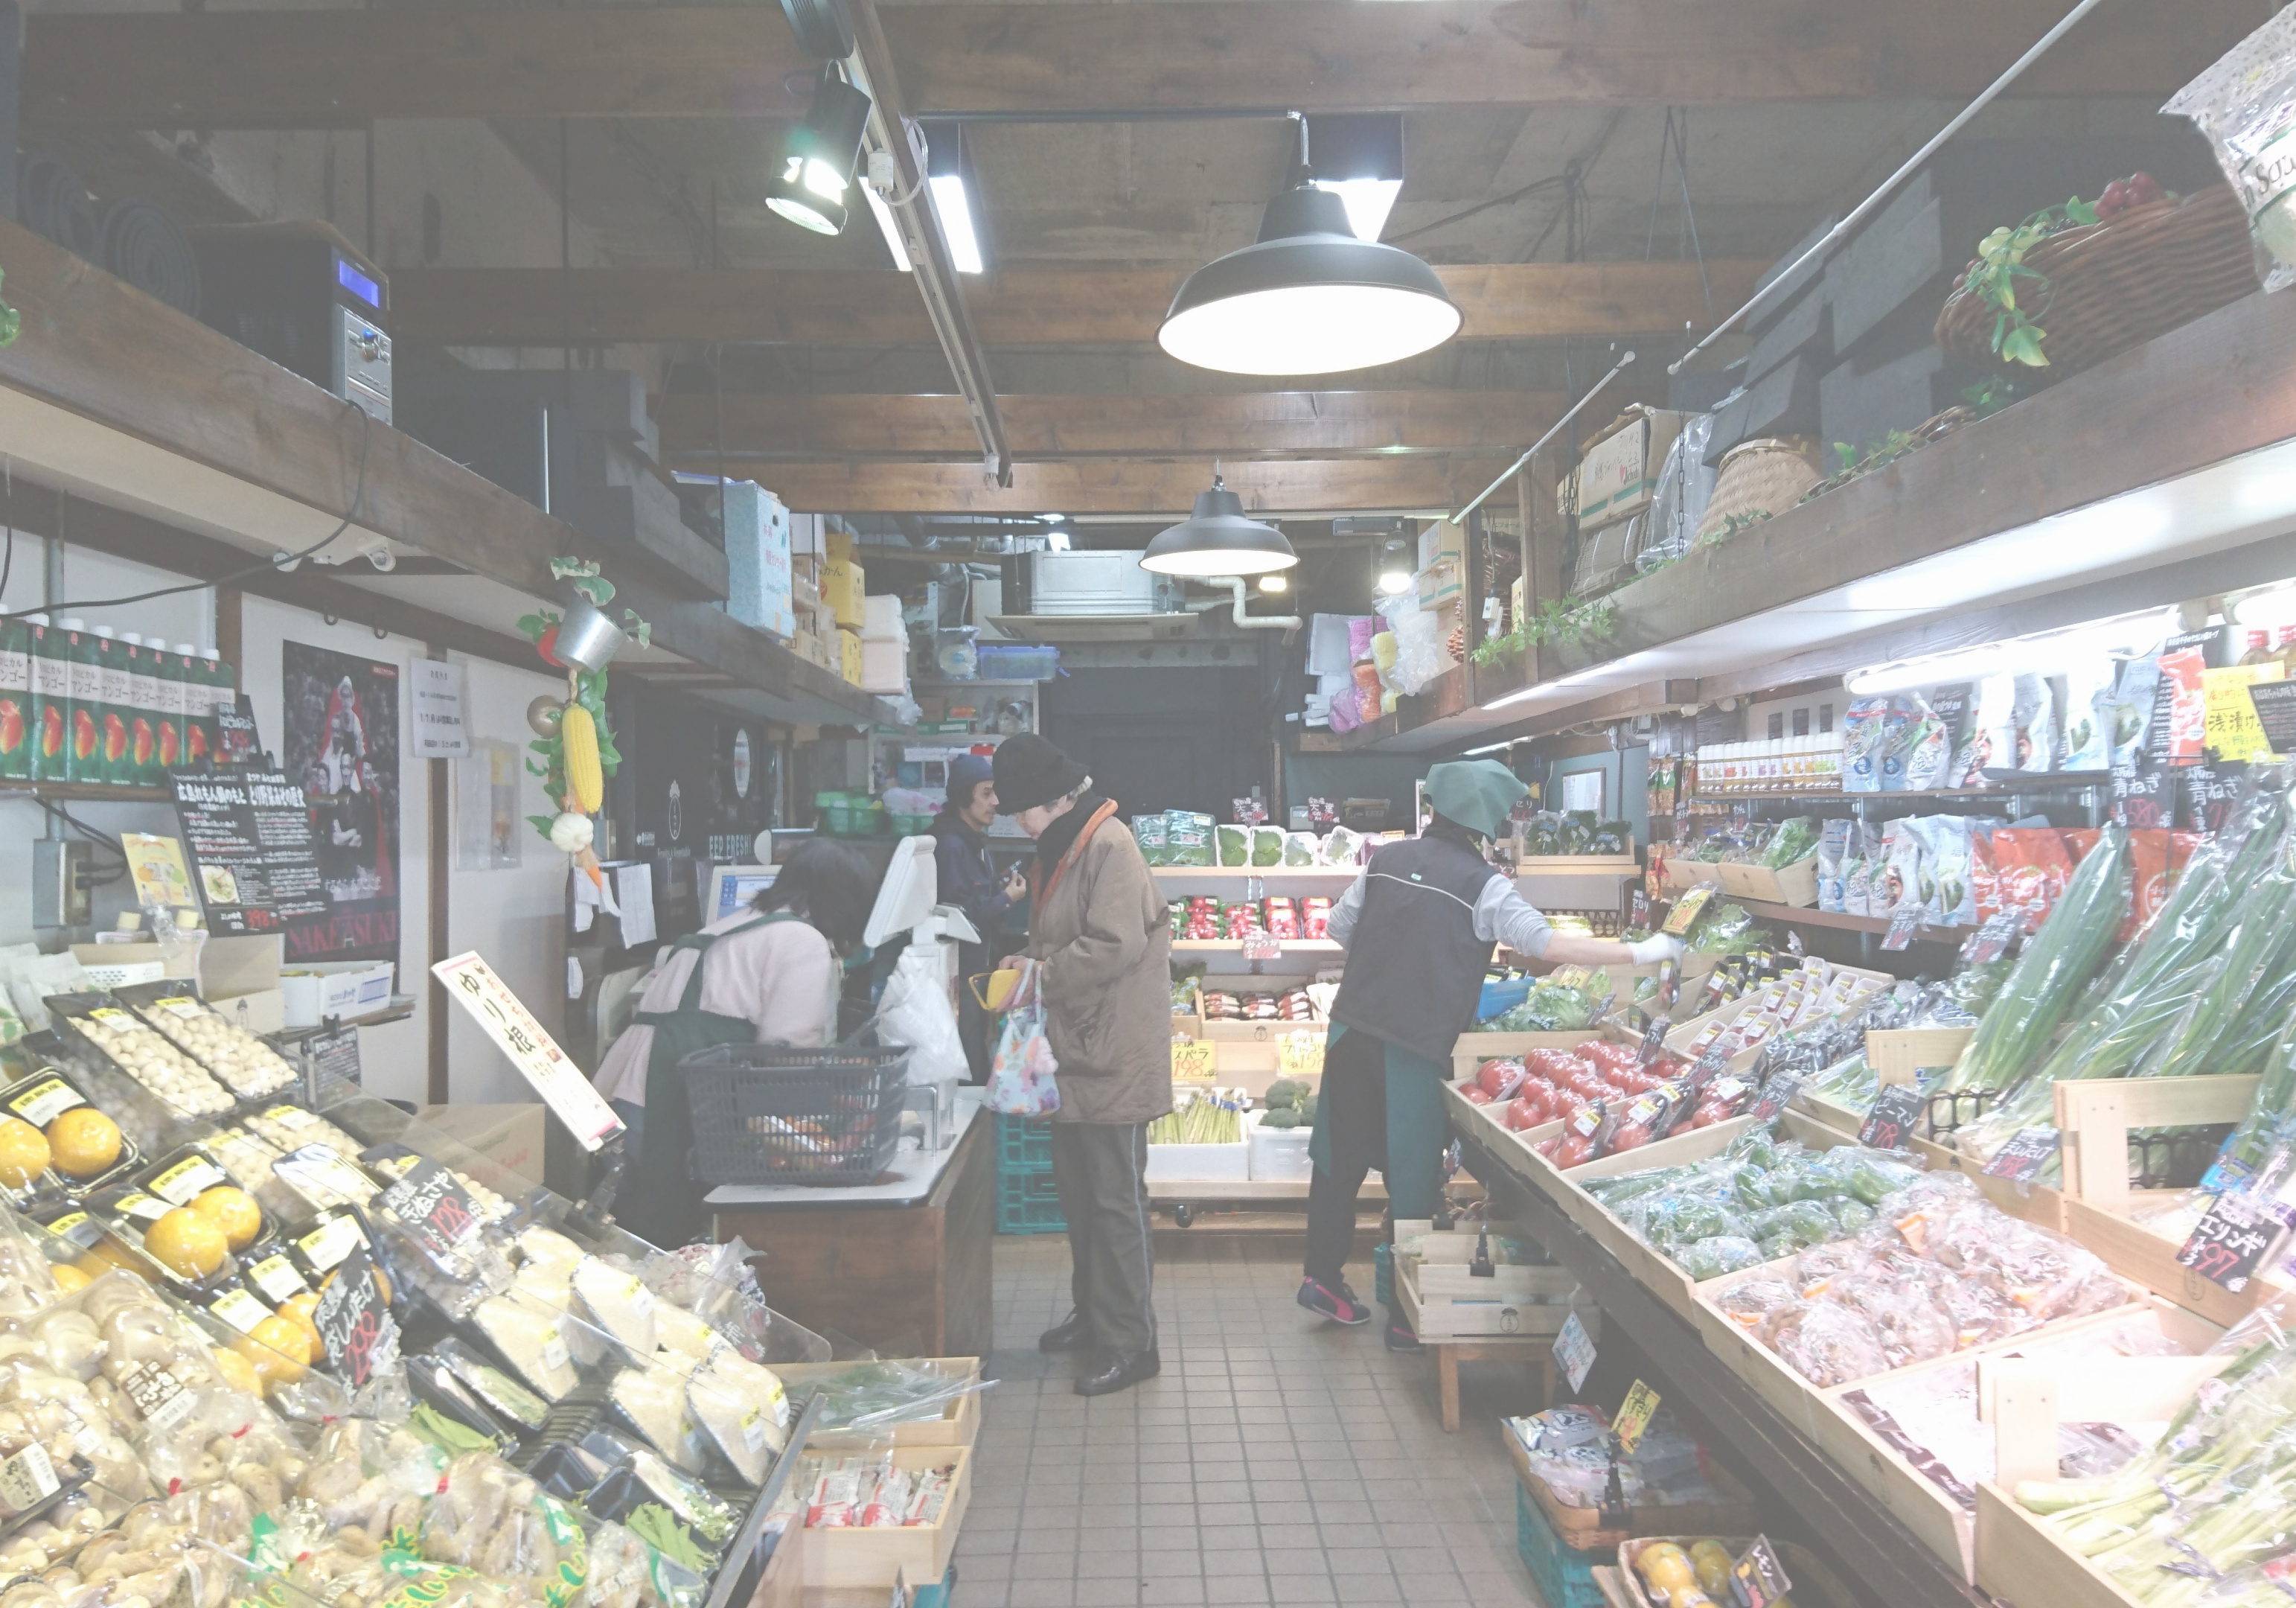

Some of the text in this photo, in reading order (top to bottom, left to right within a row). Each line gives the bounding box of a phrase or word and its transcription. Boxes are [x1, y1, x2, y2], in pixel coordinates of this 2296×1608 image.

[38, 674, 65, 689] マンゴー
[71, 680, 99, 694] マンゴー
[101, 685, 129, 699] マンゴー
[130, 690, 156, 704] マンゴー
[156, 694, 182, 707] マンゴー
[185, 698, 211, 711] マンゴー
[2208, 711, 2256, 733] 浅漬け
[2111, 773, 2162, 799] 青ねぎ
[2187, 775, 2244, 806] 青ねぎ
[1235, 802, 1263, 812] 大葉
[1310, 803, 1334, 814] 大葉
[1245, 939, 1279, 949] みょうが
[458, 972, 536, 1056] ゆり根
[1173, 1058, 1204, 1077] 198
[1761, 1082, 1791, 1108] きゅうり
[1874, 1098, 1918, 1128] ピーマン
[1873, 1120, 1899, 1150] 78
[398, 1170, 454, 1225] きぬさや
[429, 1196, 470, 1244] 128
[2197, 1214, 2268, 1259] エリンギ
[2194, 1242, 2241, 1280] 97
